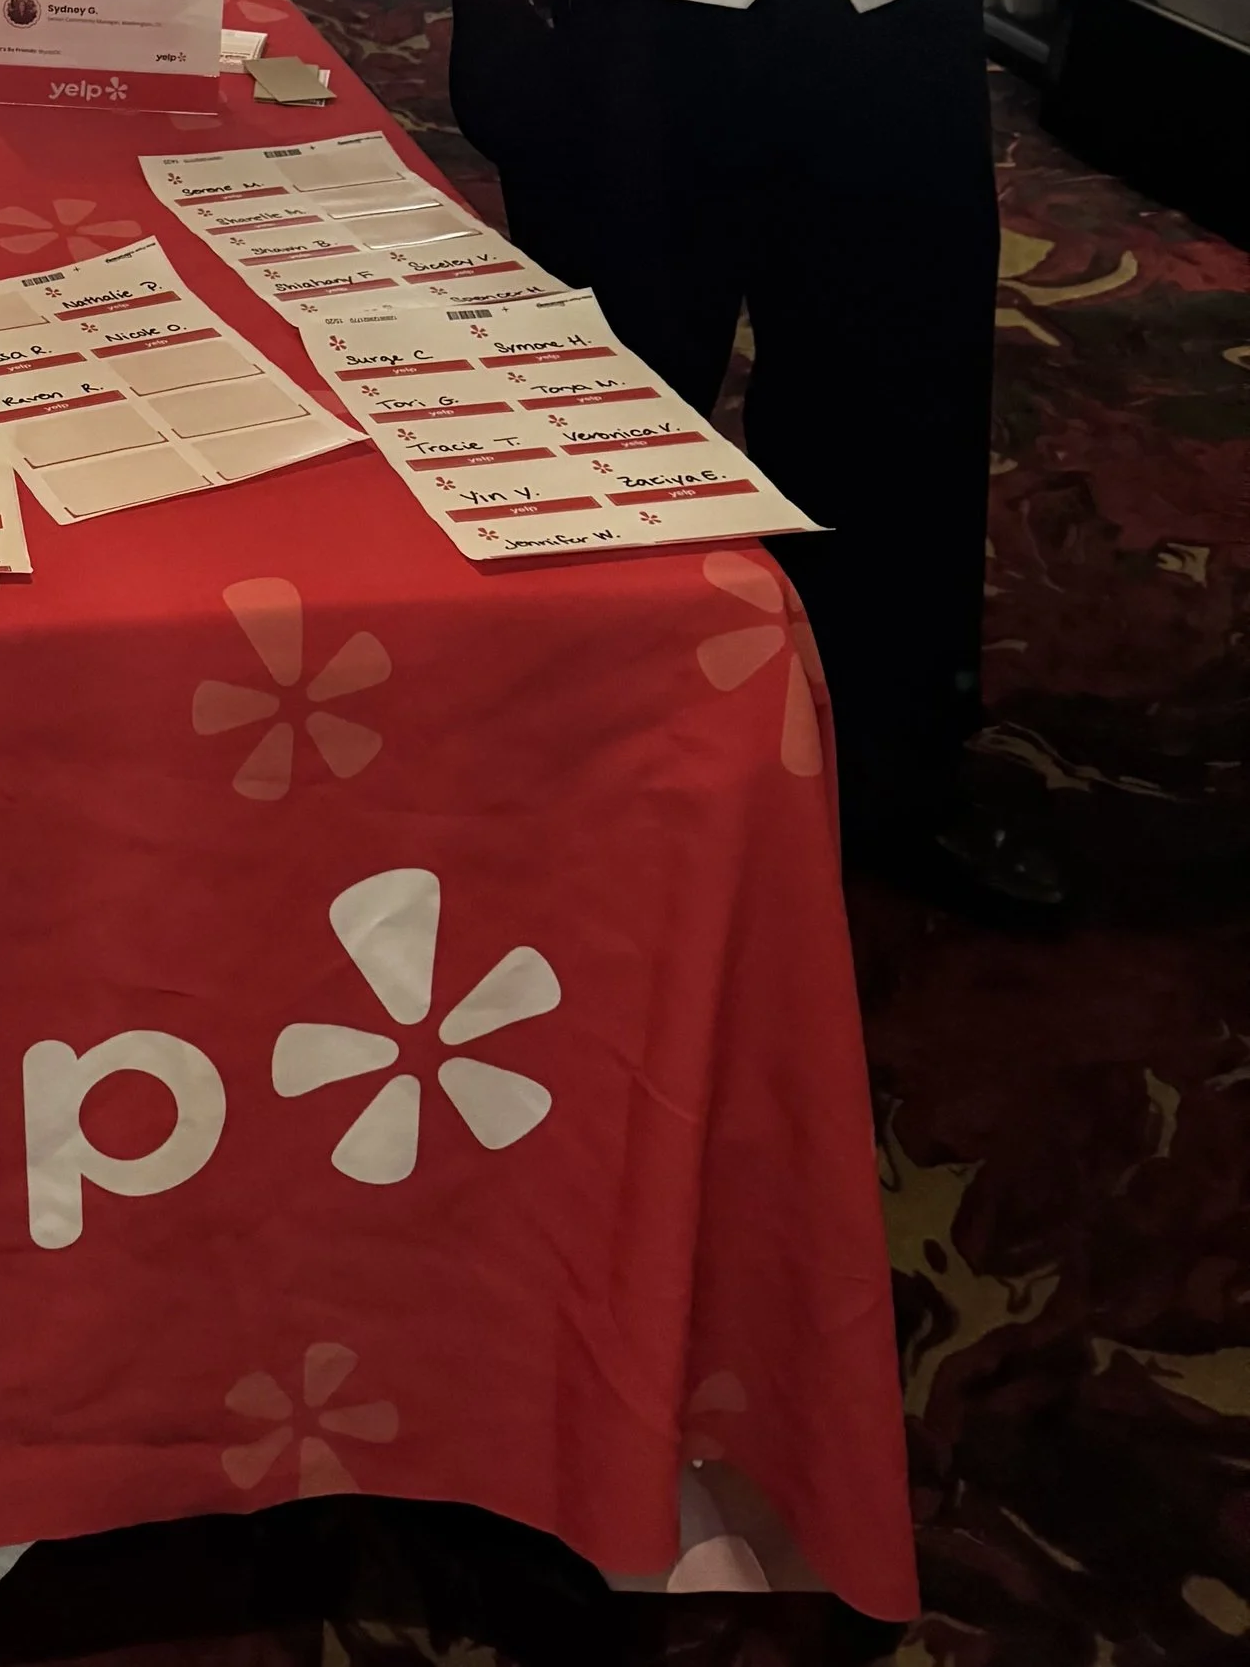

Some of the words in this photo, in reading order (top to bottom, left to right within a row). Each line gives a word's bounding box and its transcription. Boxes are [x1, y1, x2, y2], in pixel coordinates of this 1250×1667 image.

[48, 5, 85, 16] Sydney
[155, 53, 176, 62] yelp
[49, 80, 102, 101] yelp
[62, 289, 133, 310] Nathalie
[140, 281, 162, 292] P.
[104, 325, 160, 342] Nicole
[167, 324, 187, 332] O.
[568, 334, 592, 346] H.
[31, 345, 52, 356] R.
[346, 354, 404, 366] Surge
[81, 383, 104, 394] R.
[530, 384, 592, 394] Tonya
[595, 379, 625, 387] M.
[376, 399, 426, 410] Tori
[439, 396, 459, 406] G.
[562, 428, 658, 442] Veronica
[658, 422, 681, 432] V.
[406, 441, 484, 455] Tracie
[493, 437, 520, 446] T.
[701, 470, 727, 480] E.
[460, 490, 507, 505] Yin
[514, 487, 540, 499] Y.
[505, 534, 588, 550] Jennifer
[592, 529, 621, 540] W.
